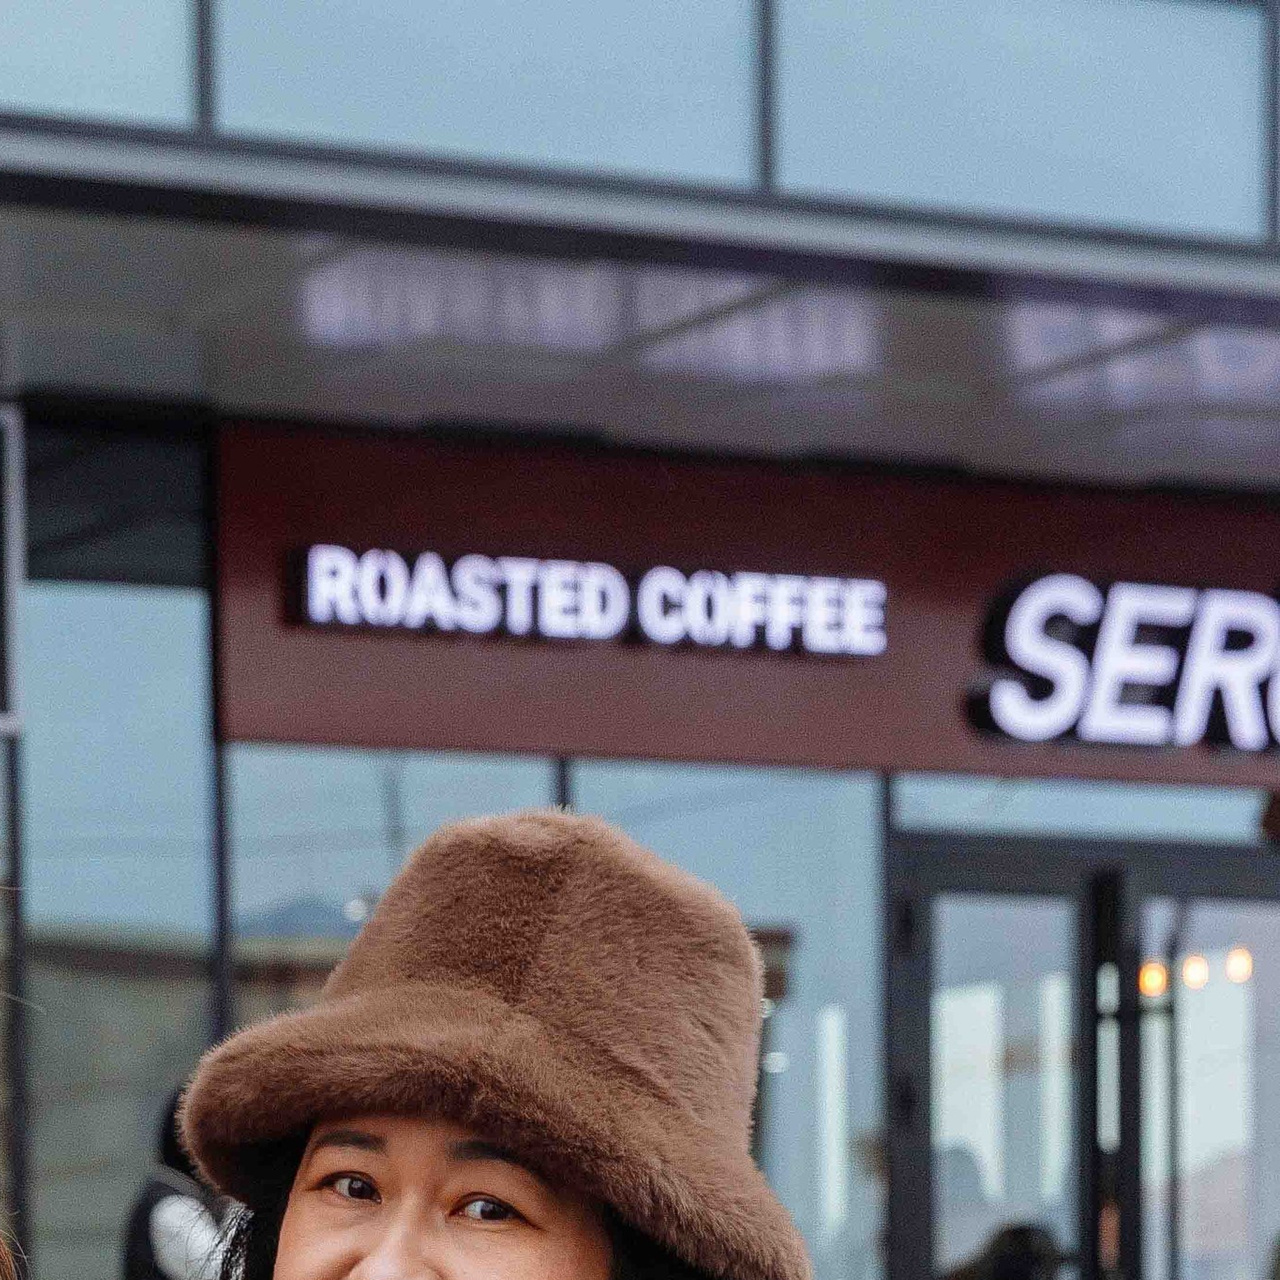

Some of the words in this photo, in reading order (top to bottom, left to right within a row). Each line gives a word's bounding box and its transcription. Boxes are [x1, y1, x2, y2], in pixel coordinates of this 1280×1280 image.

[307, 544, 629, 640] ROASTED
[637, 565, 888, 656] COFFEE
[989, 573, 1280, 750] SER
